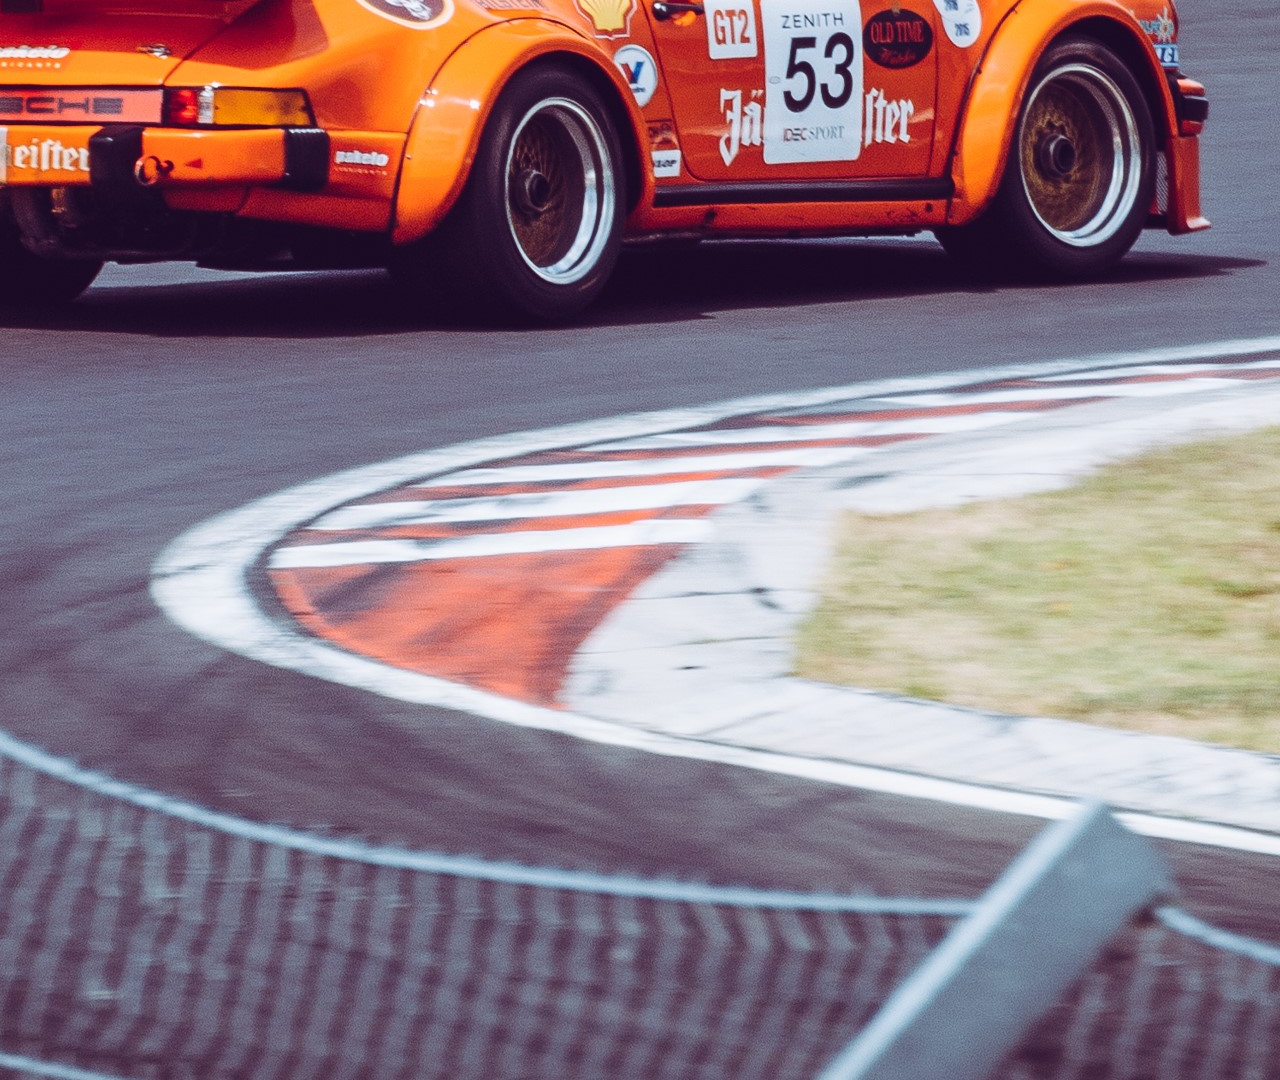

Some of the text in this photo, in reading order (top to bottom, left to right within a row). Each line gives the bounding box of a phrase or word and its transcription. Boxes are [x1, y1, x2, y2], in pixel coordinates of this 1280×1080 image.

[713, 8, 750, 46] GT2
[781, 12, 845, 29] ZENITH
[870, 20, 924, 44] OLD TIME
[783, 31, 855, 113] 53
[808, 126, 846, 140] SPORT
